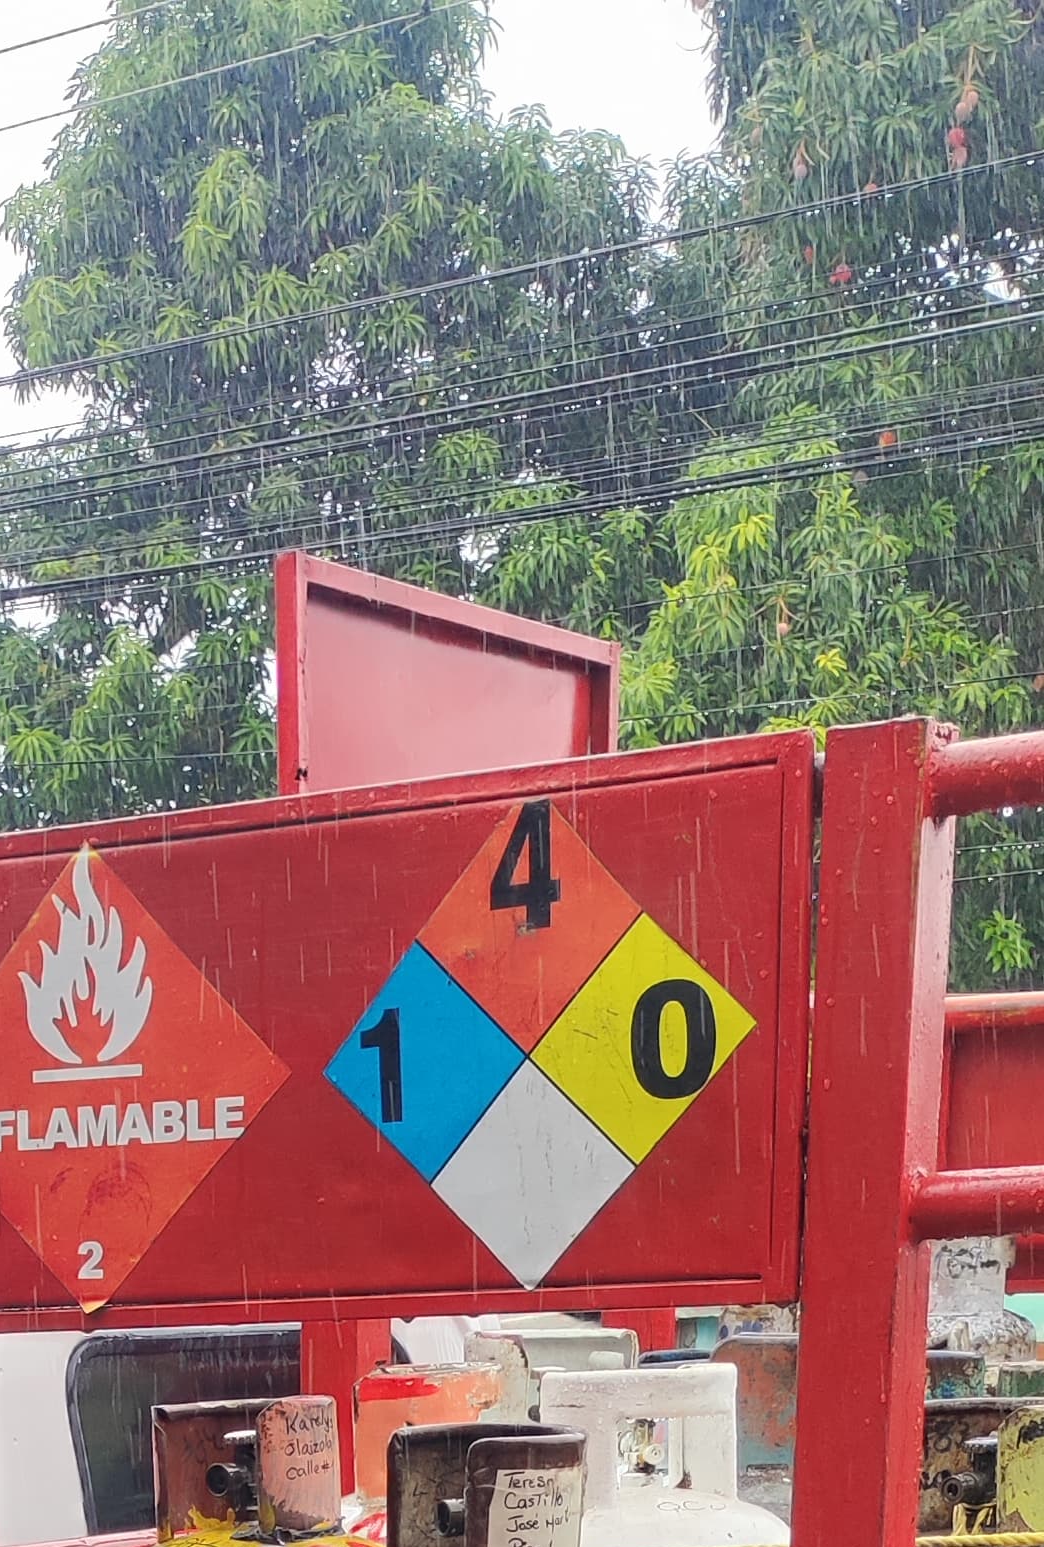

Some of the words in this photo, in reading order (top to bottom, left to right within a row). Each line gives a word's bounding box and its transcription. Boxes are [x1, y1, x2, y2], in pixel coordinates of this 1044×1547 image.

[489, 800, 560, 929] 4
[359, 1007, 404, 1123] 1
[630, 979, 717, 1099] 0
[77, 1241, 104, 1280] 2
